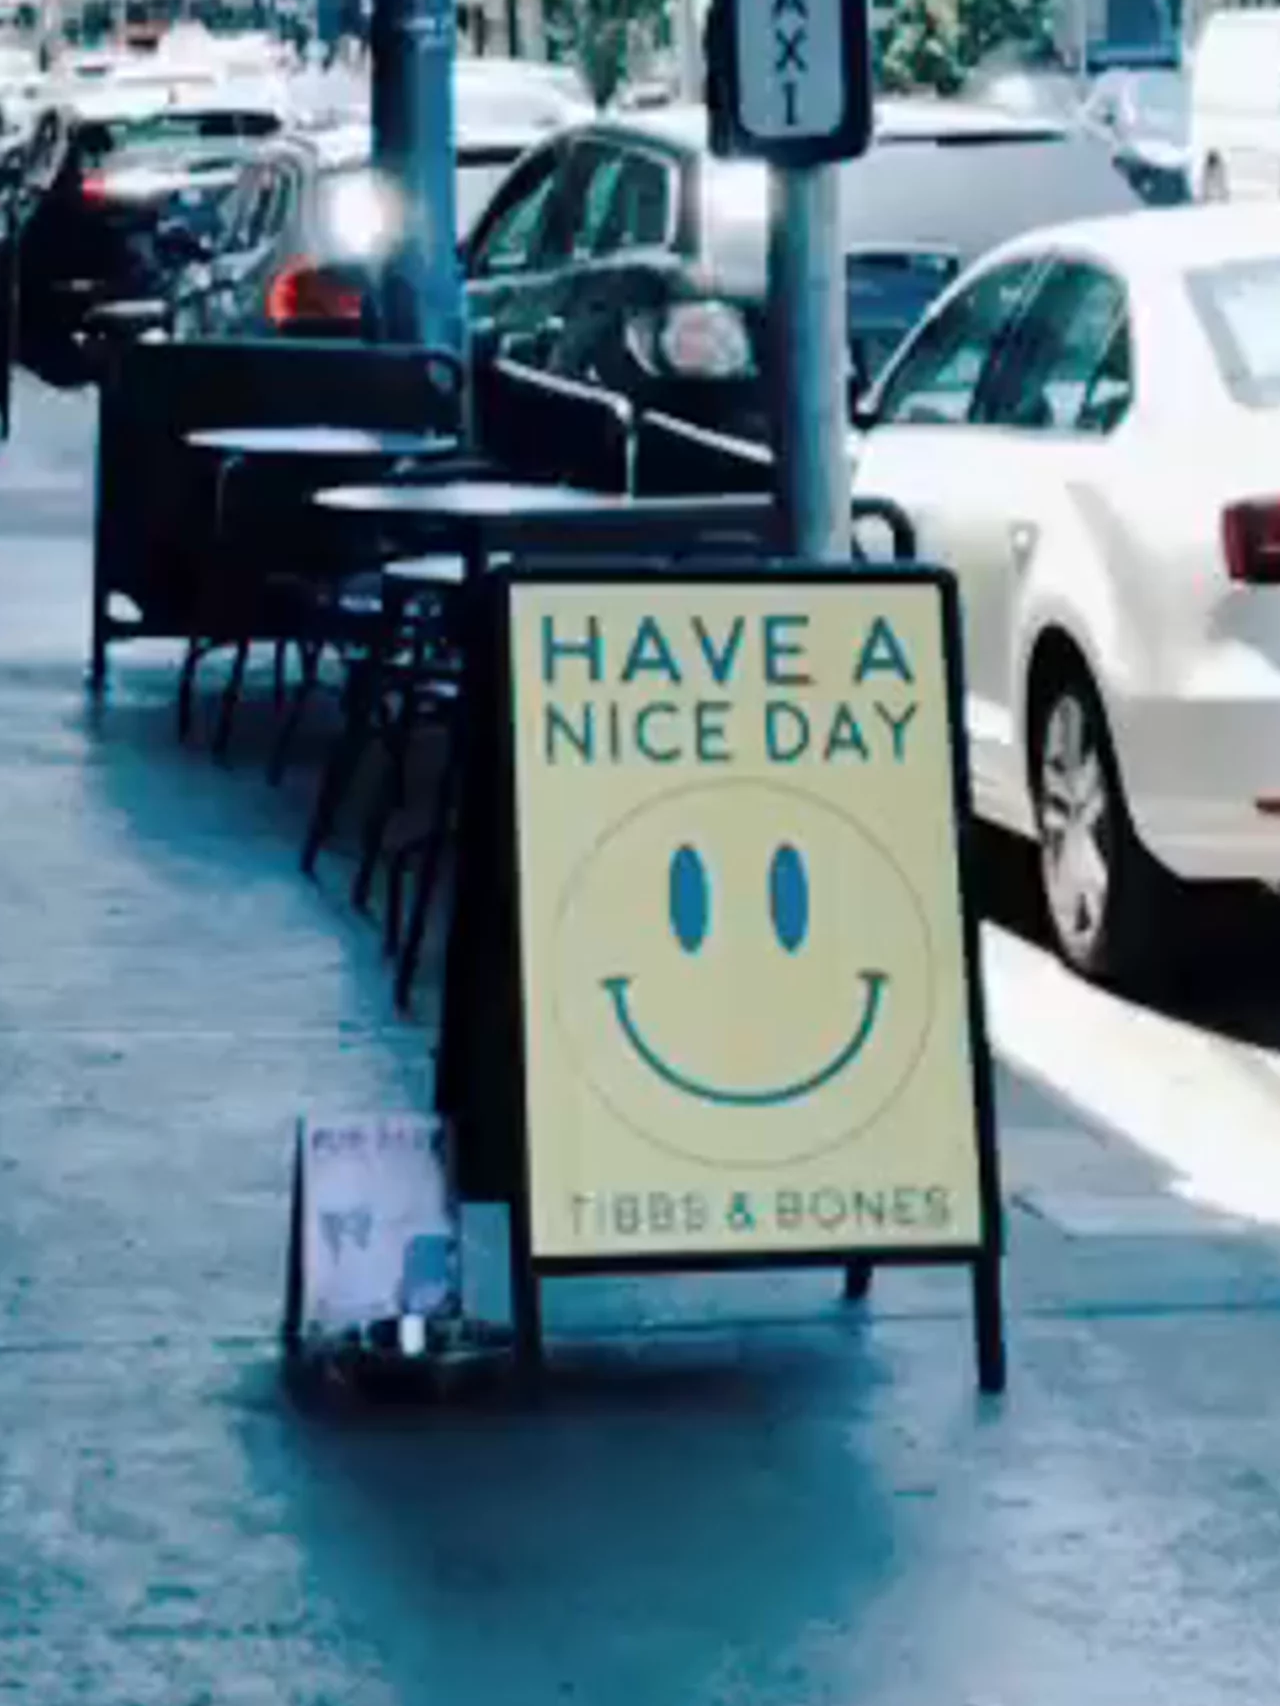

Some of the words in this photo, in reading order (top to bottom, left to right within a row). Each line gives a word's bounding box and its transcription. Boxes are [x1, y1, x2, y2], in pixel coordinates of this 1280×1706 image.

[541, 615, 816, 685] HAVE
[853, 616, 914, 684] A
[546, 700, 733, 764] NICE
[764, 700, 920, 764] DAY
[572, 1191, 709, 1236] TIBBS
[727, 1191, 757, 1234] &
[776, 1186, 952, 1230] BONES
